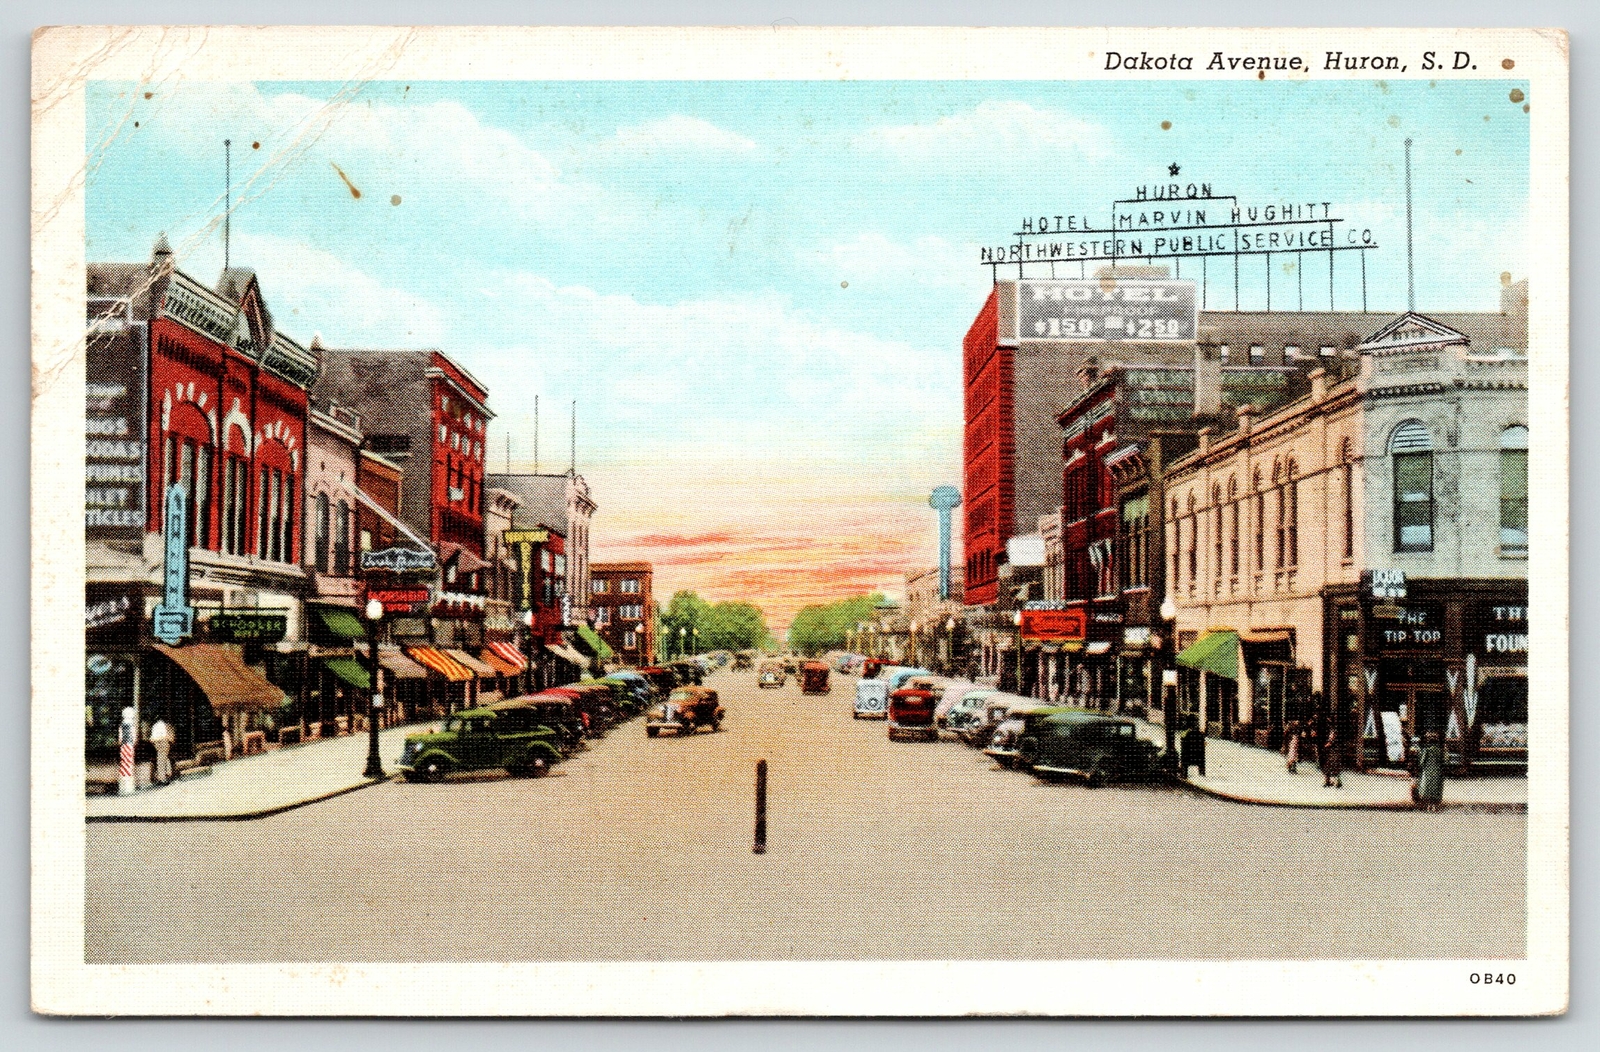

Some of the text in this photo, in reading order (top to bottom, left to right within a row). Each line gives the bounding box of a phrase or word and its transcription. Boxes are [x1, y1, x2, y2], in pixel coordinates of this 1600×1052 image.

[1104, 51, 1478, 73] Dakota Avenue, Huron, S. D.
[1136, 183, 1212, 200] HURON
[1022, 202, 1331, 232] HOTEL MARVIN HUGHITT
[981, 229, 1377, 261] NORTHWESTERN PUBLIC SERVICE CO.
[1032, 286, 1179, 302] HOTEL
